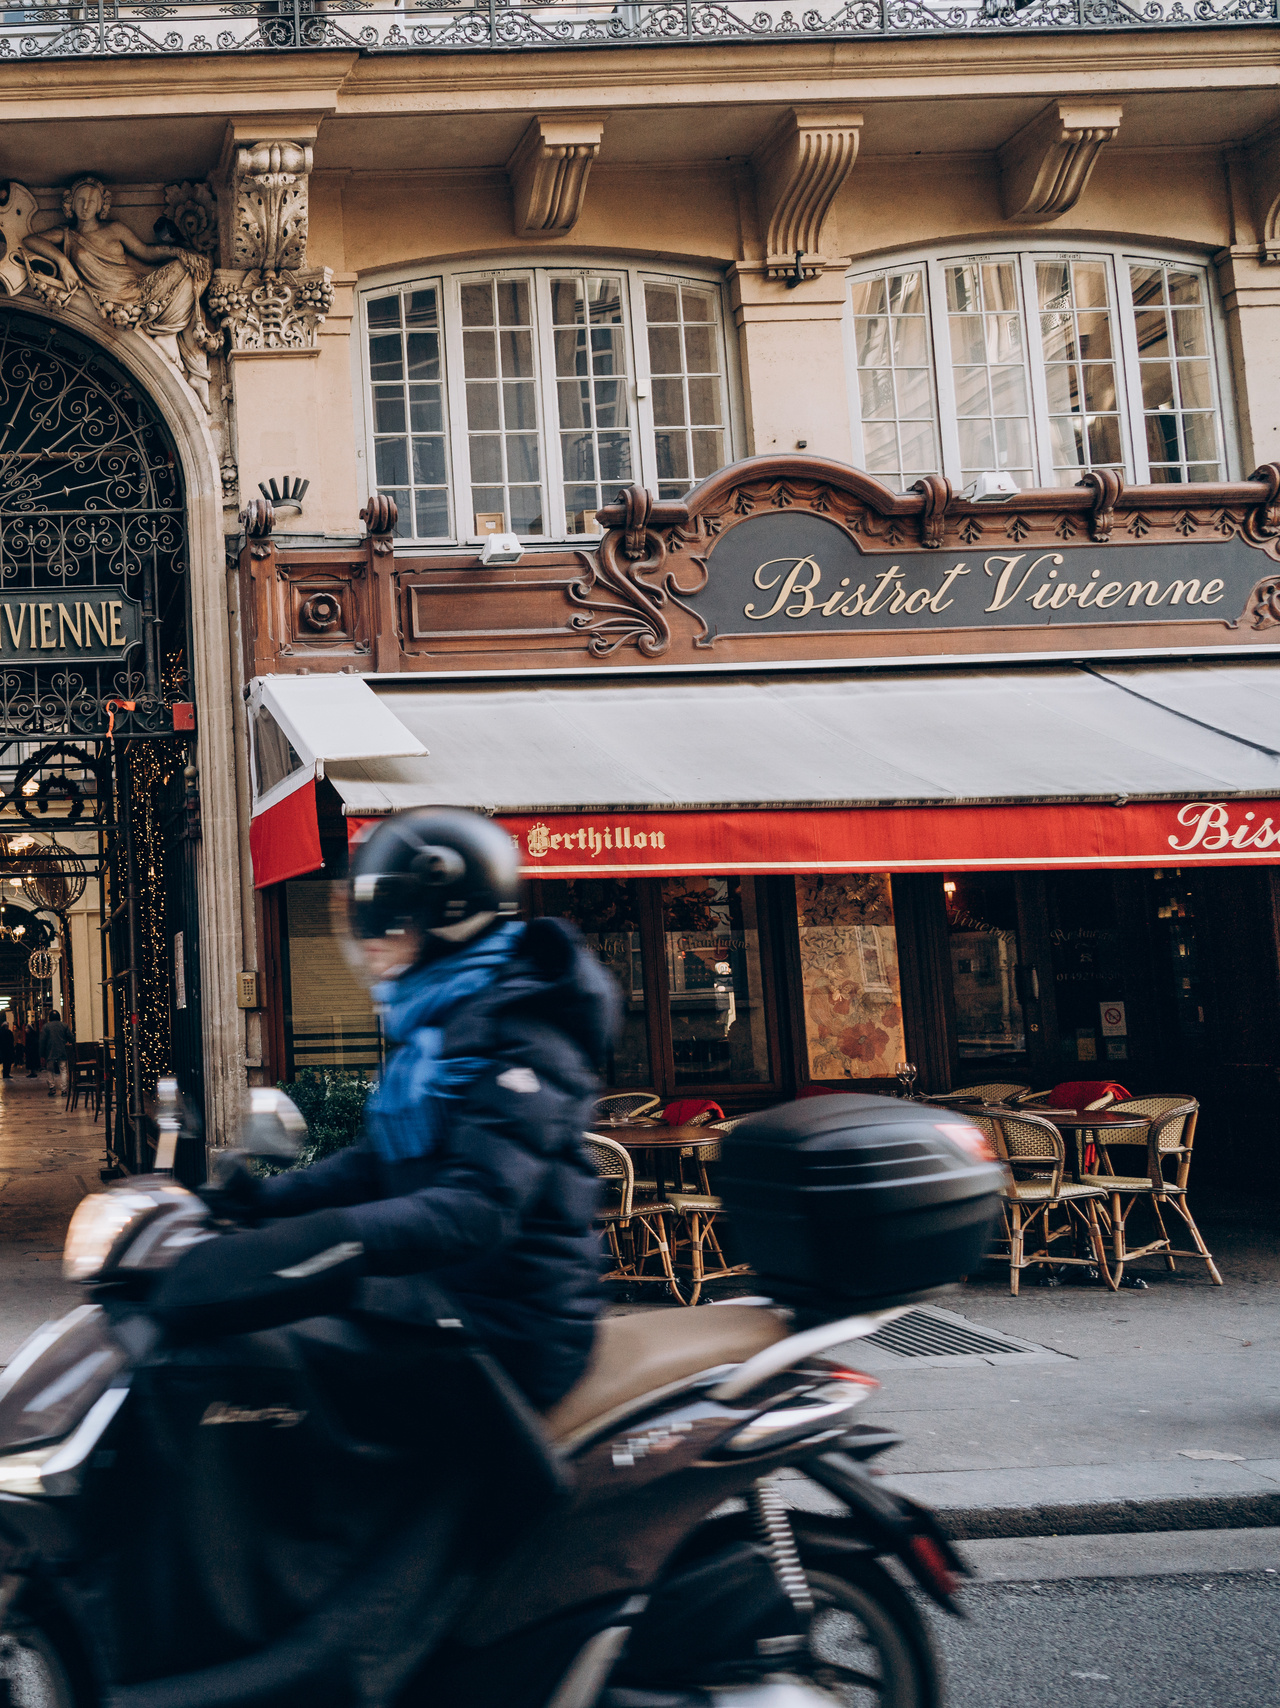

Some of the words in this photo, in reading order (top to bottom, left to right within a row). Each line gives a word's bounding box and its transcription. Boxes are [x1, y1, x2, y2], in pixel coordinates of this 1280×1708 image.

[743, 554, 971, 620] Bistrot
[983, 553, 1226, 613] Vivienne
[526, 822, 666, 858] Berthillon
[1168, 802, 1280, 851] Bis
[676, 935, 750, 955] Champagne
